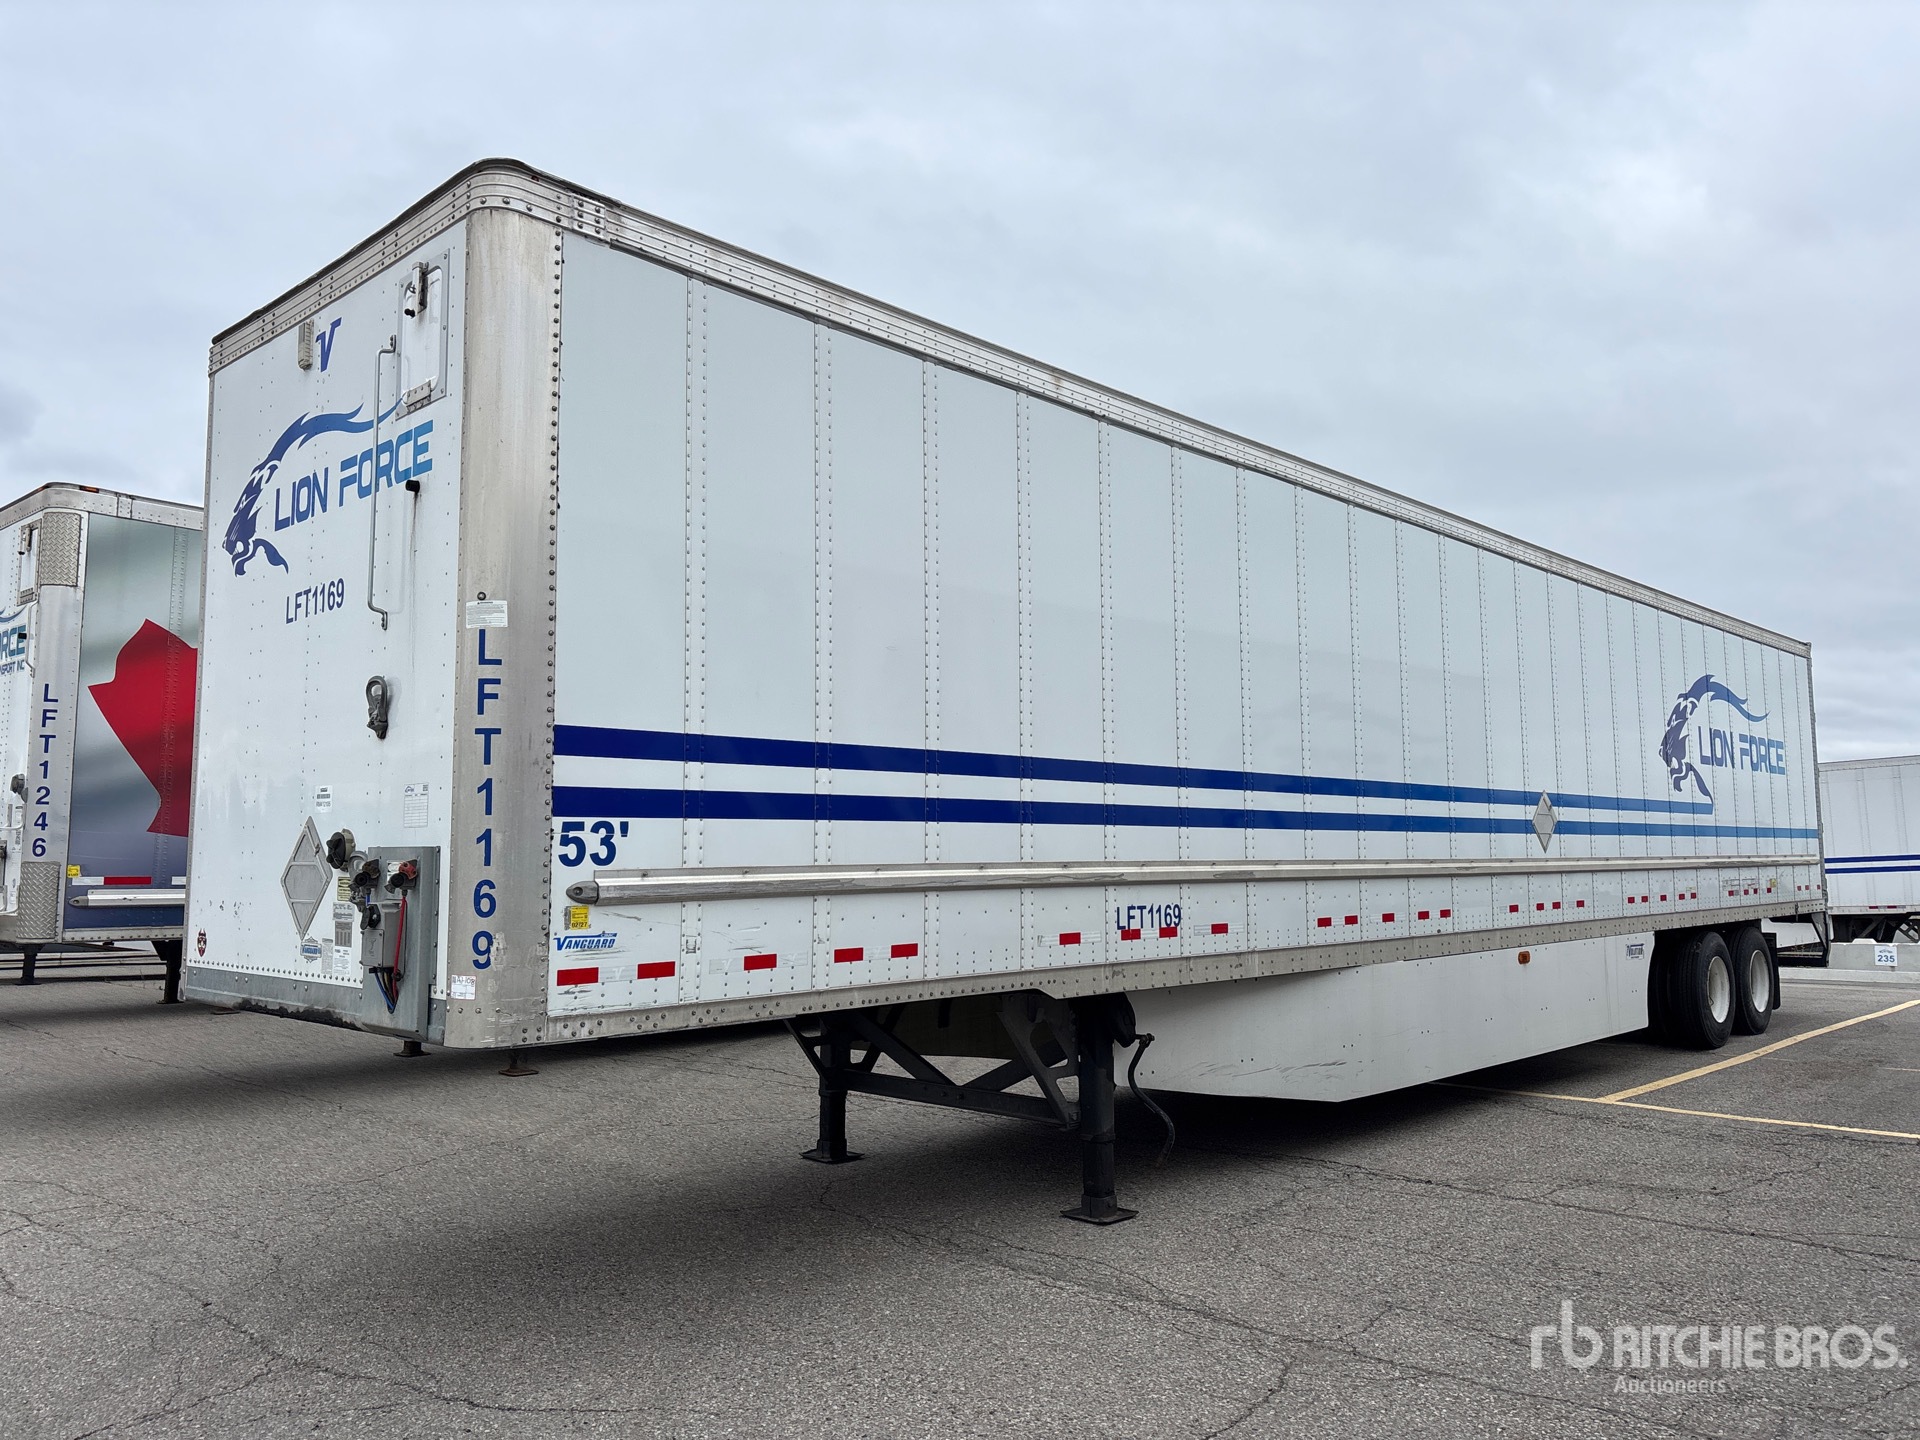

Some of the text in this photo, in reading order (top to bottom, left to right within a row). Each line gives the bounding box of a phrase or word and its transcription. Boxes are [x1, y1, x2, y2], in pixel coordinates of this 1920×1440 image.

[274, 419, 434, 532] LION FORCE
[285, 577, 345, 624] LFT1169
[0, 624, 26, 660] RCE
[31, 683, 59, 857] LFT1246
[1698, 725, 1786, 776] LION FORCE
[472, 628, 503, 970] LFT1169
[1116, 904, 1181, 930] LFT1169
[553, 934, 616, 951] VANGUARD
[1877, 954, 1896, 963] 235
